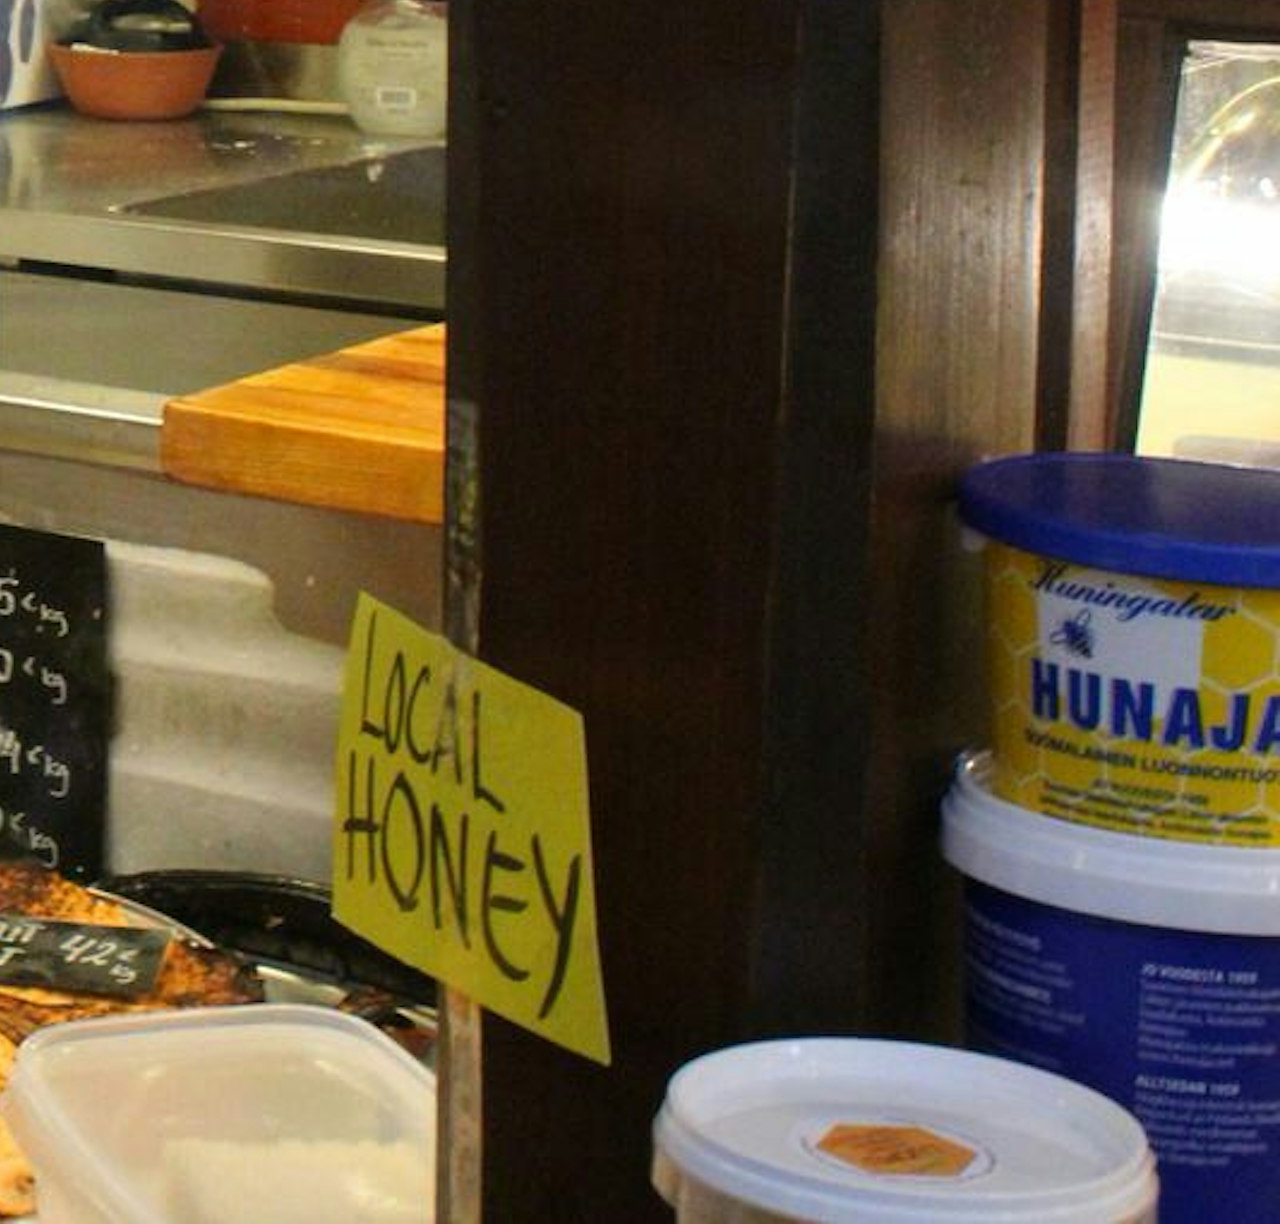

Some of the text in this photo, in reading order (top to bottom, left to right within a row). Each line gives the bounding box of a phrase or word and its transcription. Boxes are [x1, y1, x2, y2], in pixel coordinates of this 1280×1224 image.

[1027, 559, 1239, 624] Kuningatar
[360, 608, 506, 815] LOCAL
[59, 934, 112, 967] 42
[342, 748, 582, 1022] HONEY
